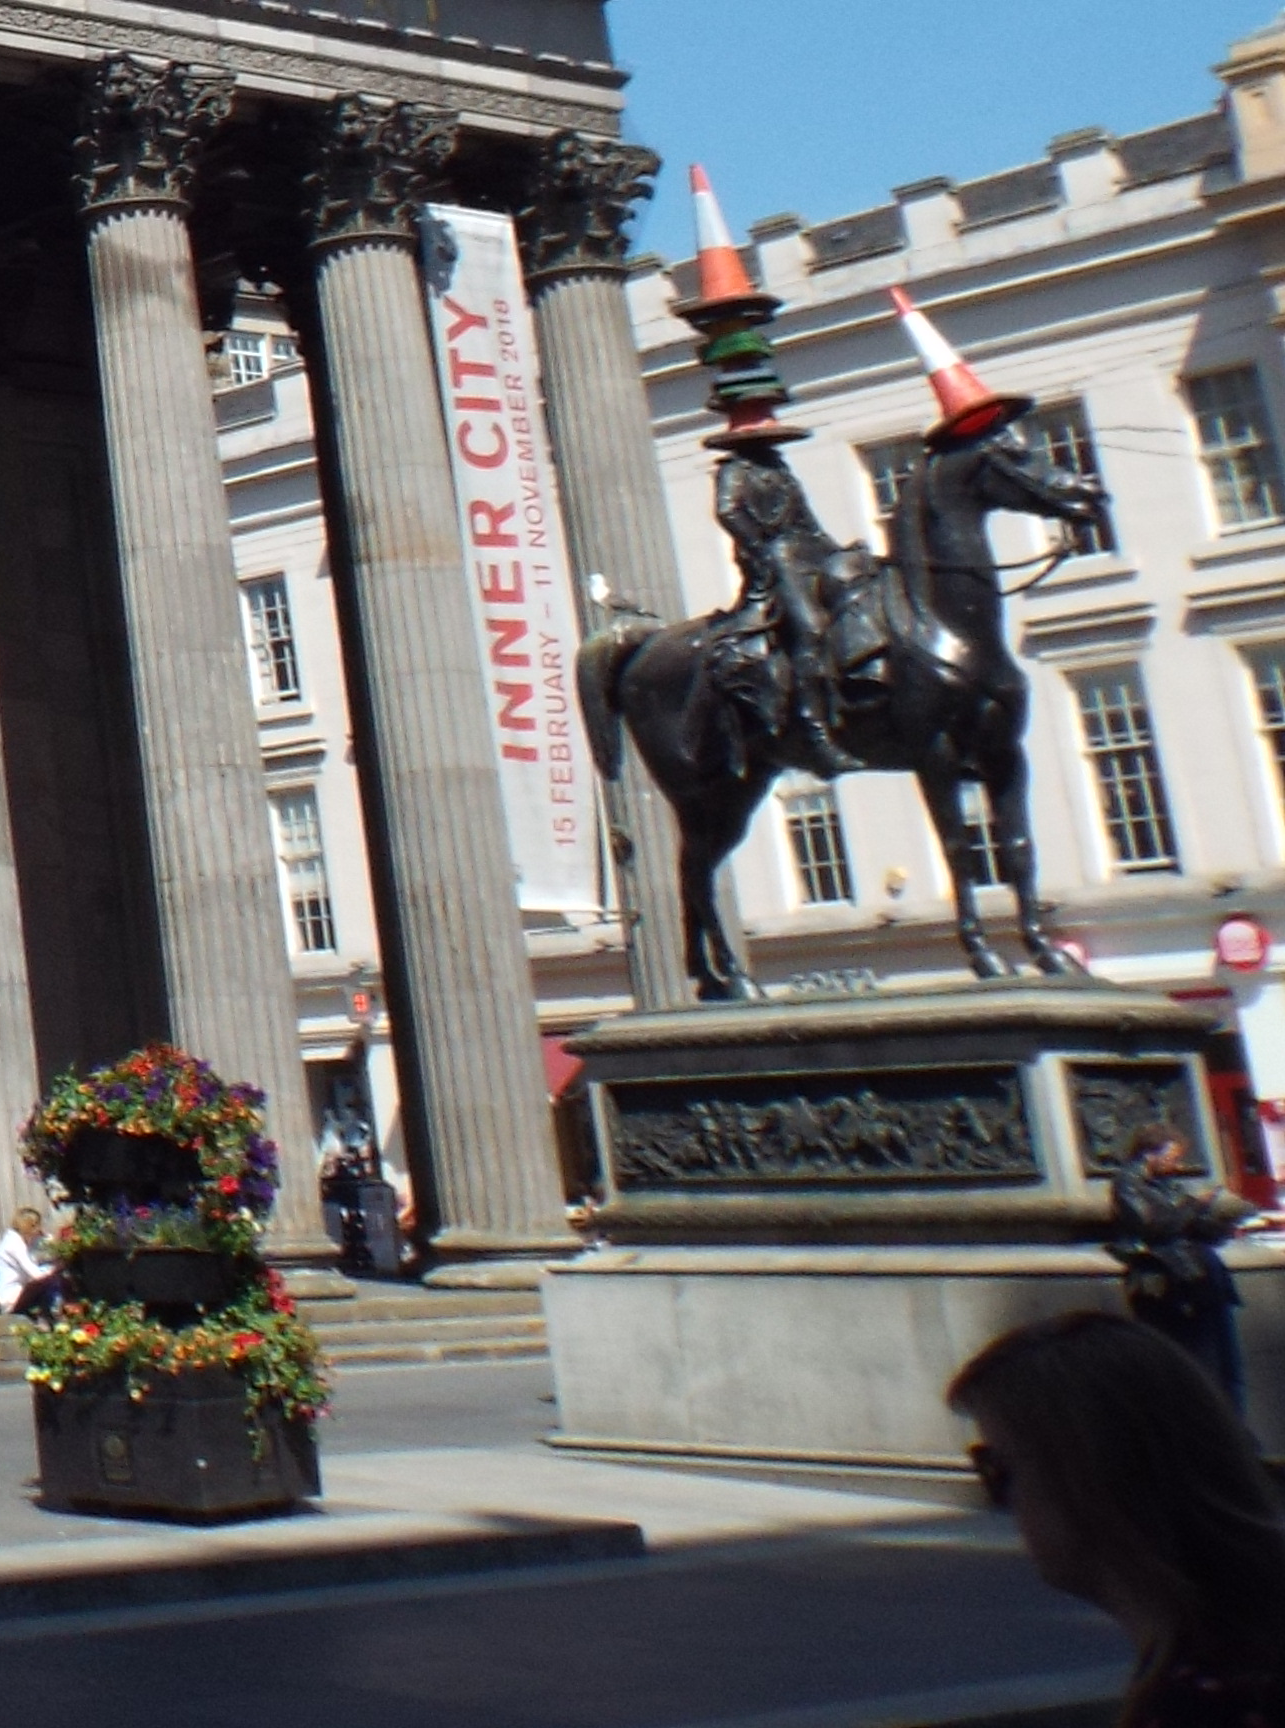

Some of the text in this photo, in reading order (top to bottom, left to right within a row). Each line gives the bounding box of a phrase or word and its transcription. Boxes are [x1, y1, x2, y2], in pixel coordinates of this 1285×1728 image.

[494, 299, 519, 362] 2018
[504, 373, 547, 548] NOVEMBER
[442, 294, 540, 763] INNER CITY
[532, 563, 553, 587] 11
[539, 632, 574, 804] FEBRUARY
[552, 816, 576, 847] 15
